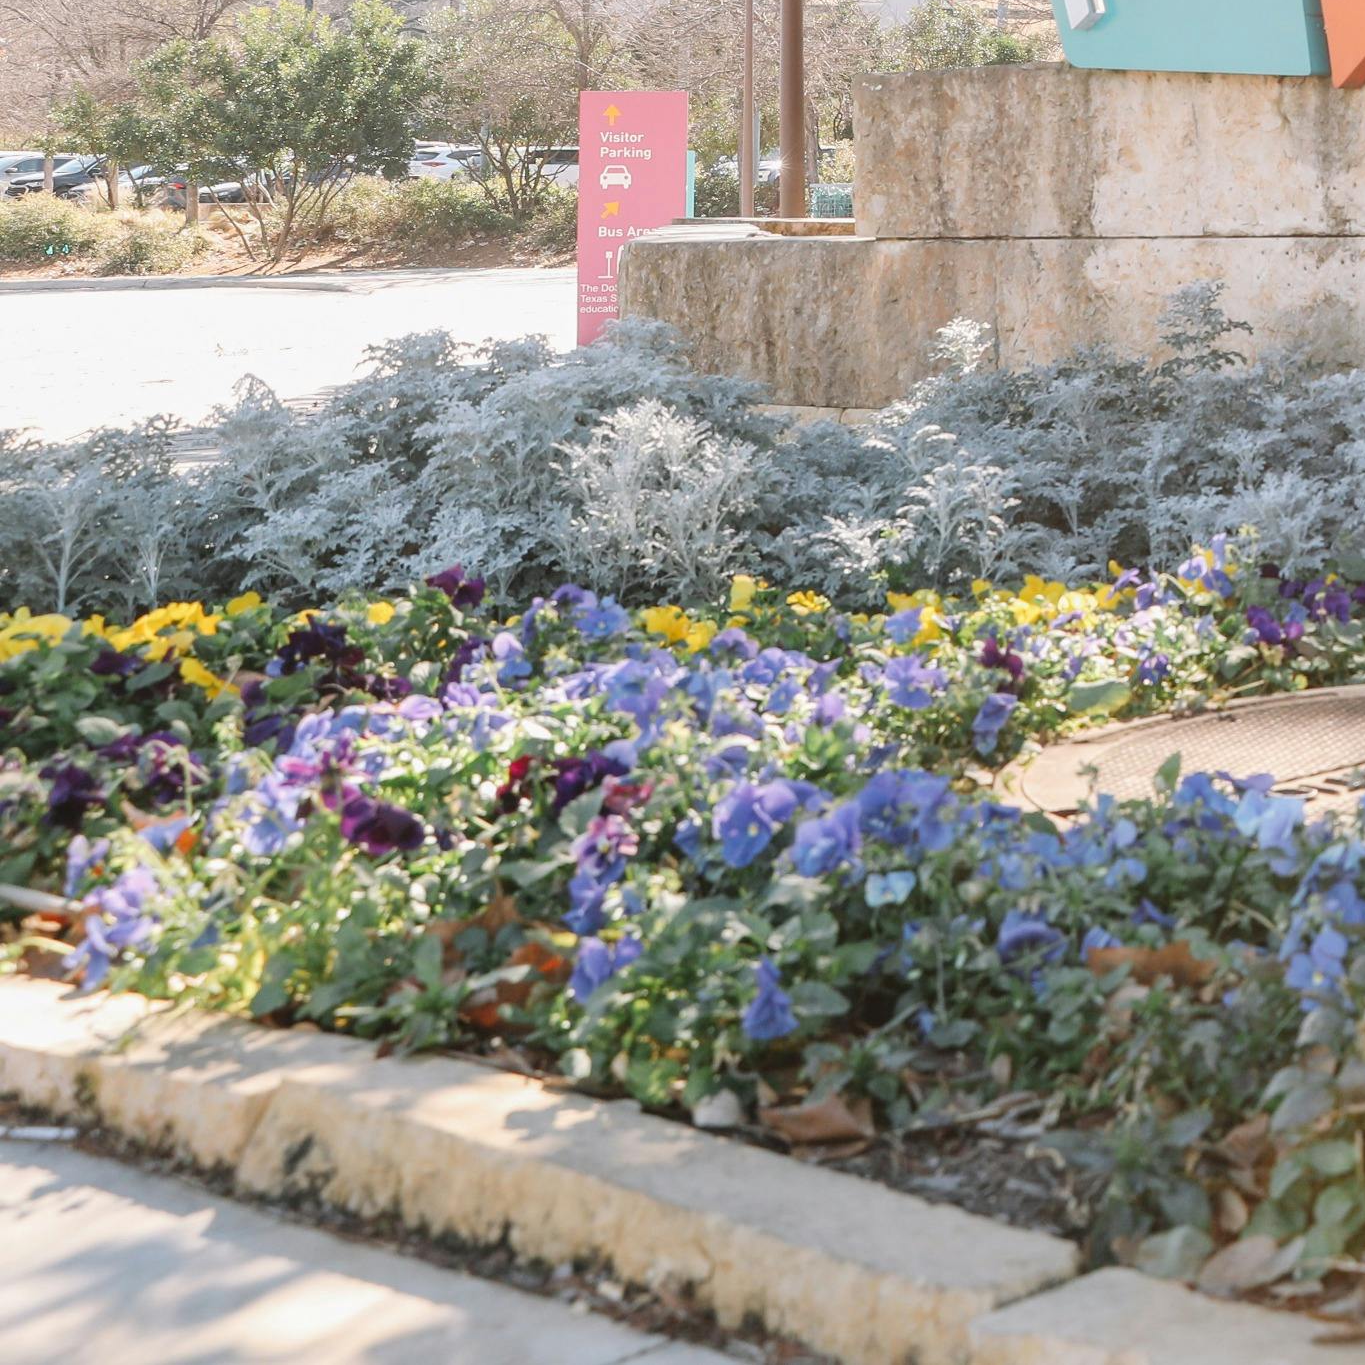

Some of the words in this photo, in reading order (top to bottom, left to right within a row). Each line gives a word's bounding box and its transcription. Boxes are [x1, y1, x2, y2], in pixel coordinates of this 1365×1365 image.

[600, 131, 645, 143] Visitor
[600, 146, 652, 161] Parking
[598, 226, 624, 237] Bus
[580, 283, 599, 292] The
[580, 294, 608, 303] Texas
